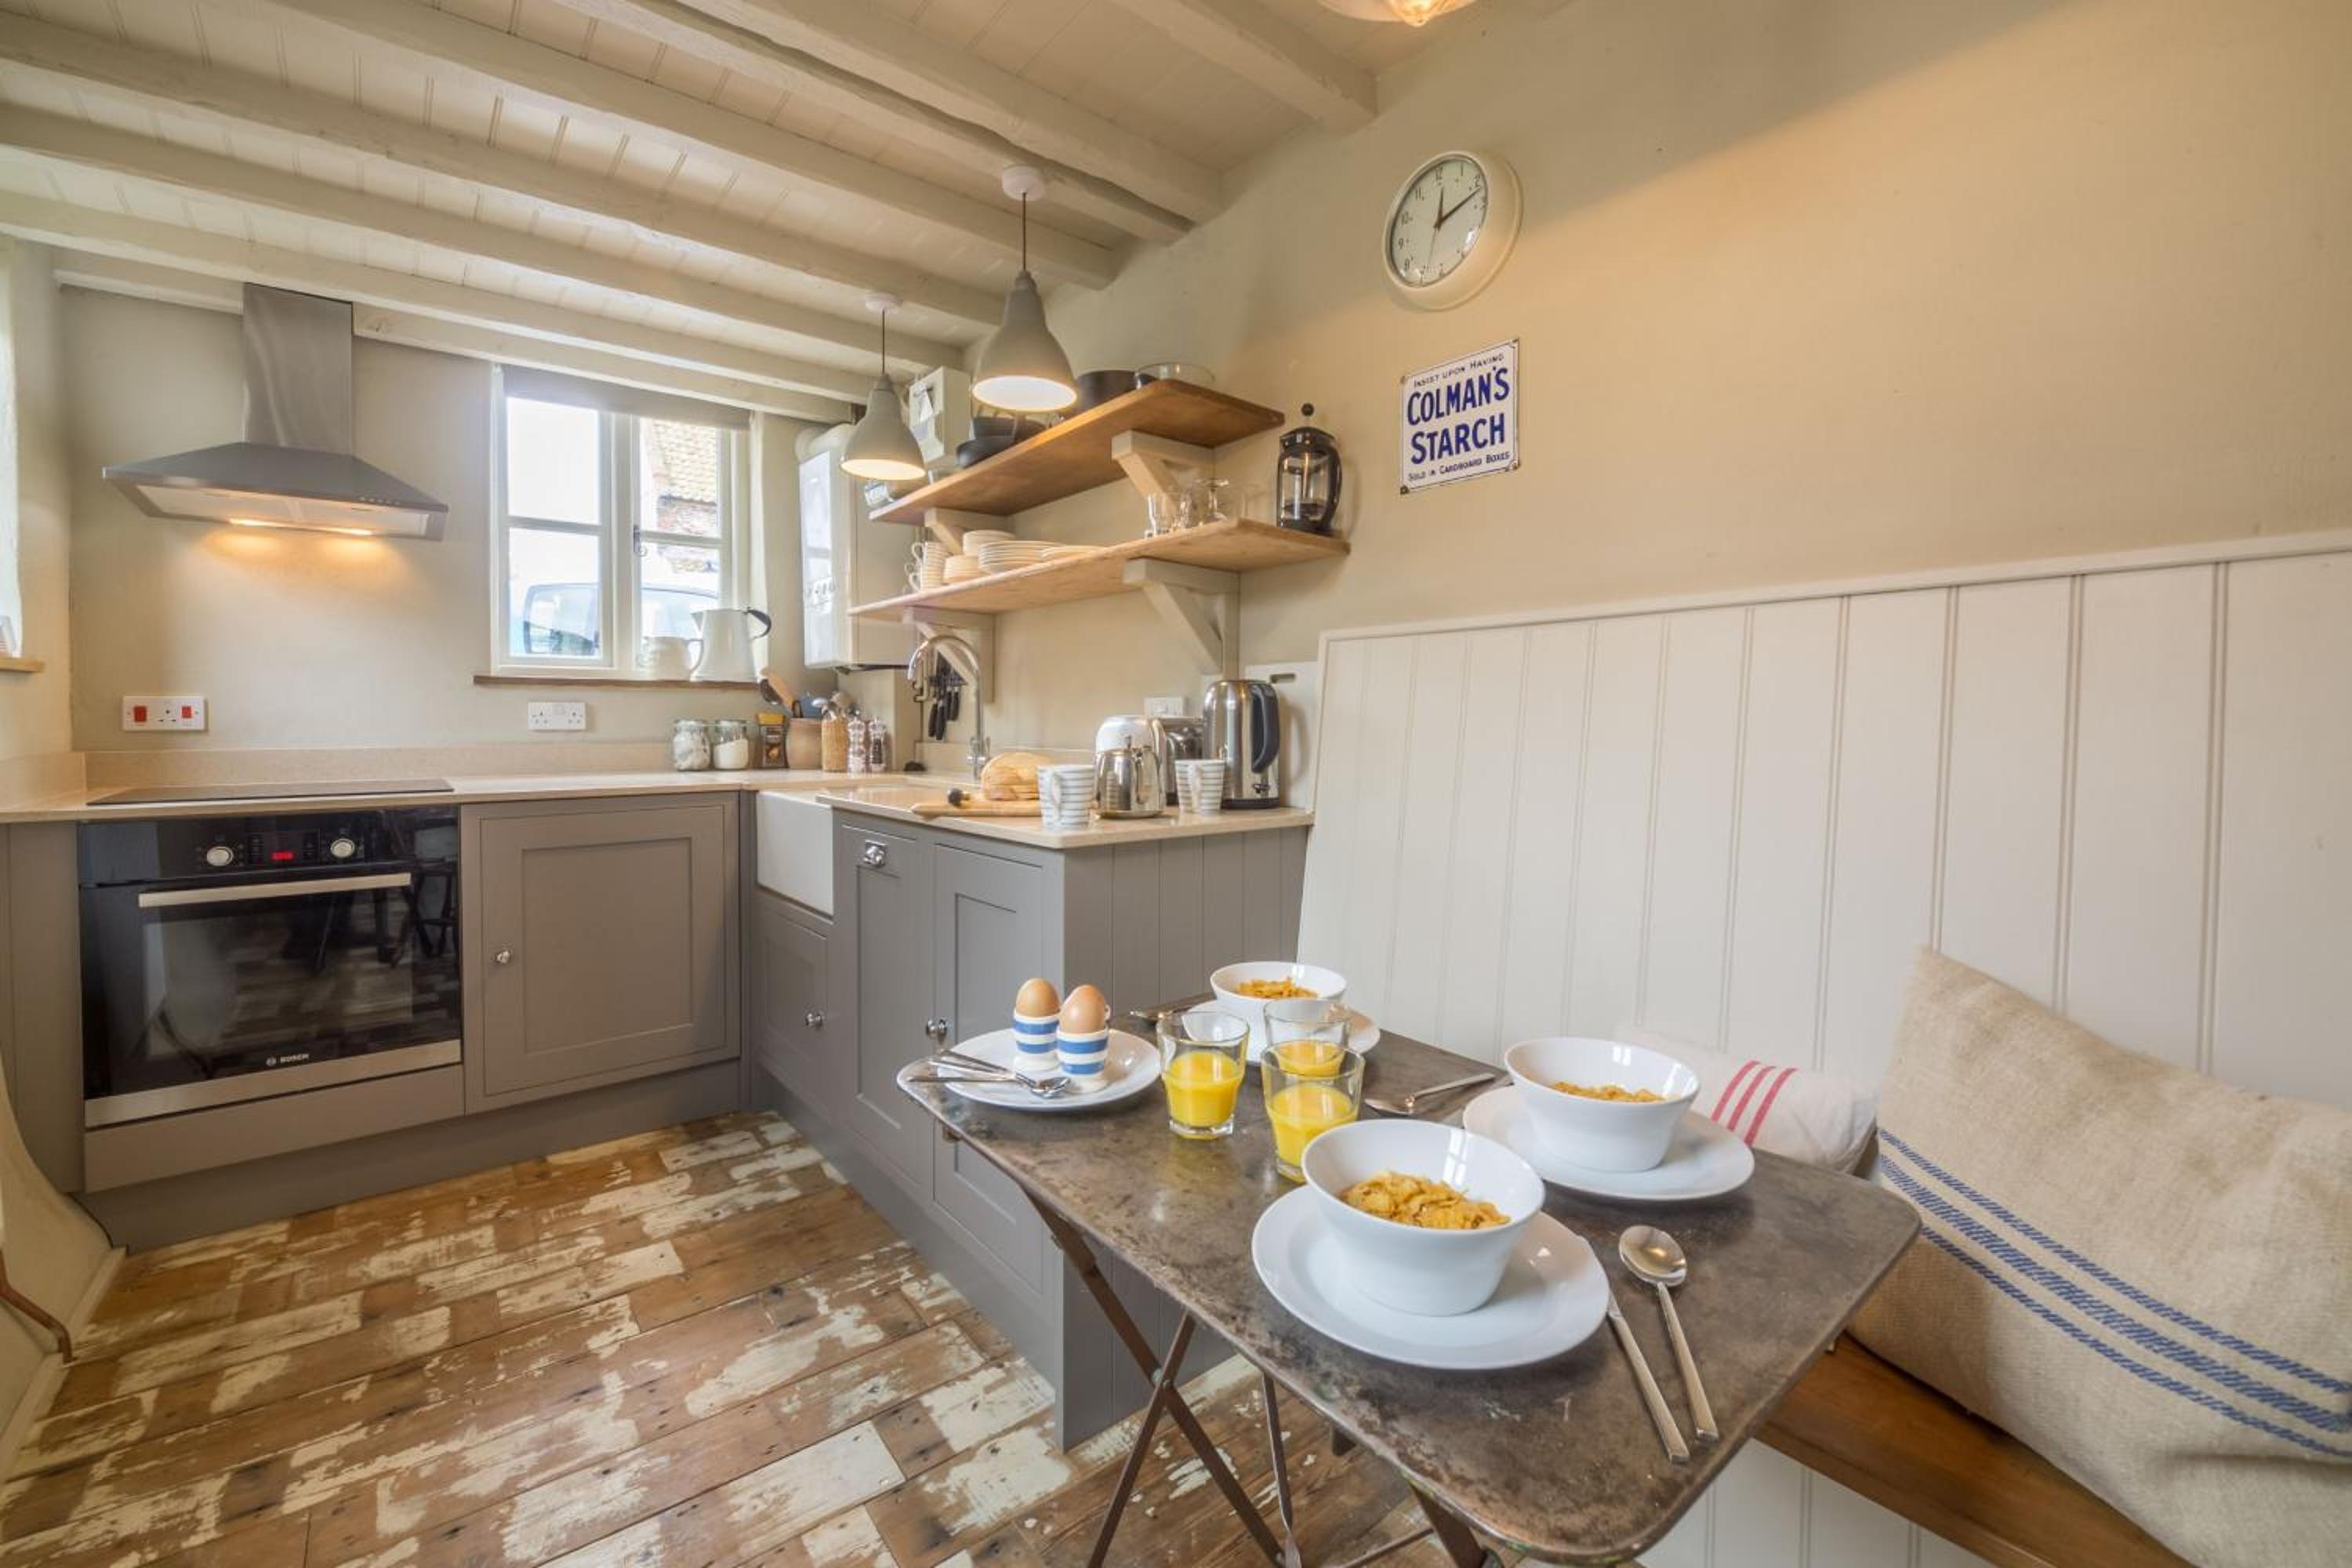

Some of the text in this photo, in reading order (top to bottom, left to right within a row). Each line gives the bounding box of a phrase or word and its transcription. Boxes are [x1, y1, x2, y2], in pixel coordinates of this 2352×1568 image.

[1407, 367, 1510, 426] COLMAN'S
[1410, 412, 1505, 465] STARCH
[1439, 458, 1483, 474] CARDBOARD
[1486, 451, 1510, 463] BOXES
